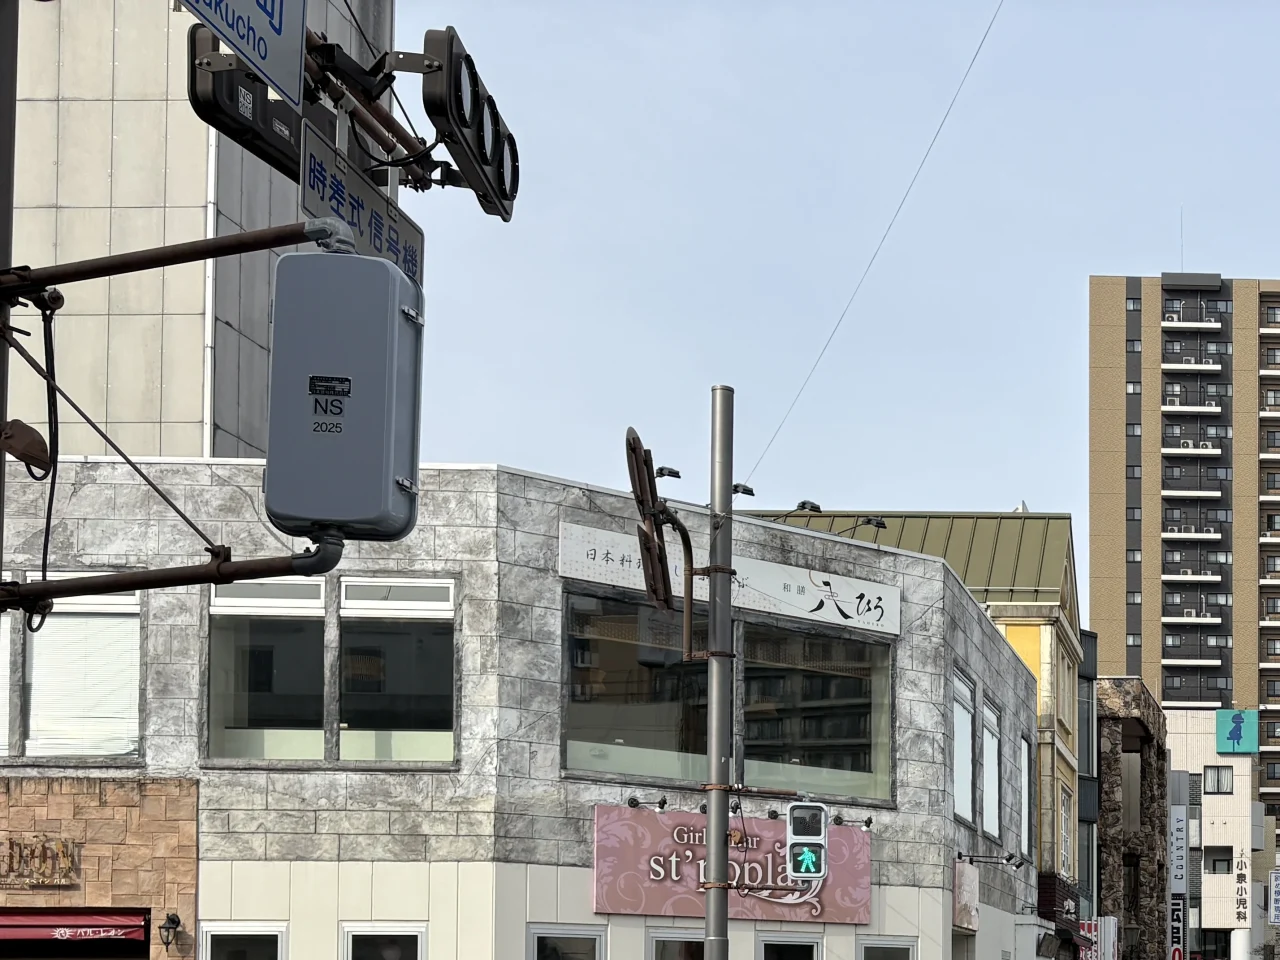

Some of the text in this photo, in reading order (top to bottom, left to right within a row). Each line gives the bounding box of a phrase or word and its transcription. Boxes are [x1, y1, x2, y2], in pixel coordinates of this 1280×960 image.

[308, 152, 418, 278] 時差式信号機
[314, 397, 343, 416] NS
[313, 421, 343, 434] 2025
[673, 826, 707, 845] Girl
[1174, 817, 1184, 880] COUNTRY
[1236, 860, 1248, 923] 小泉小児科
